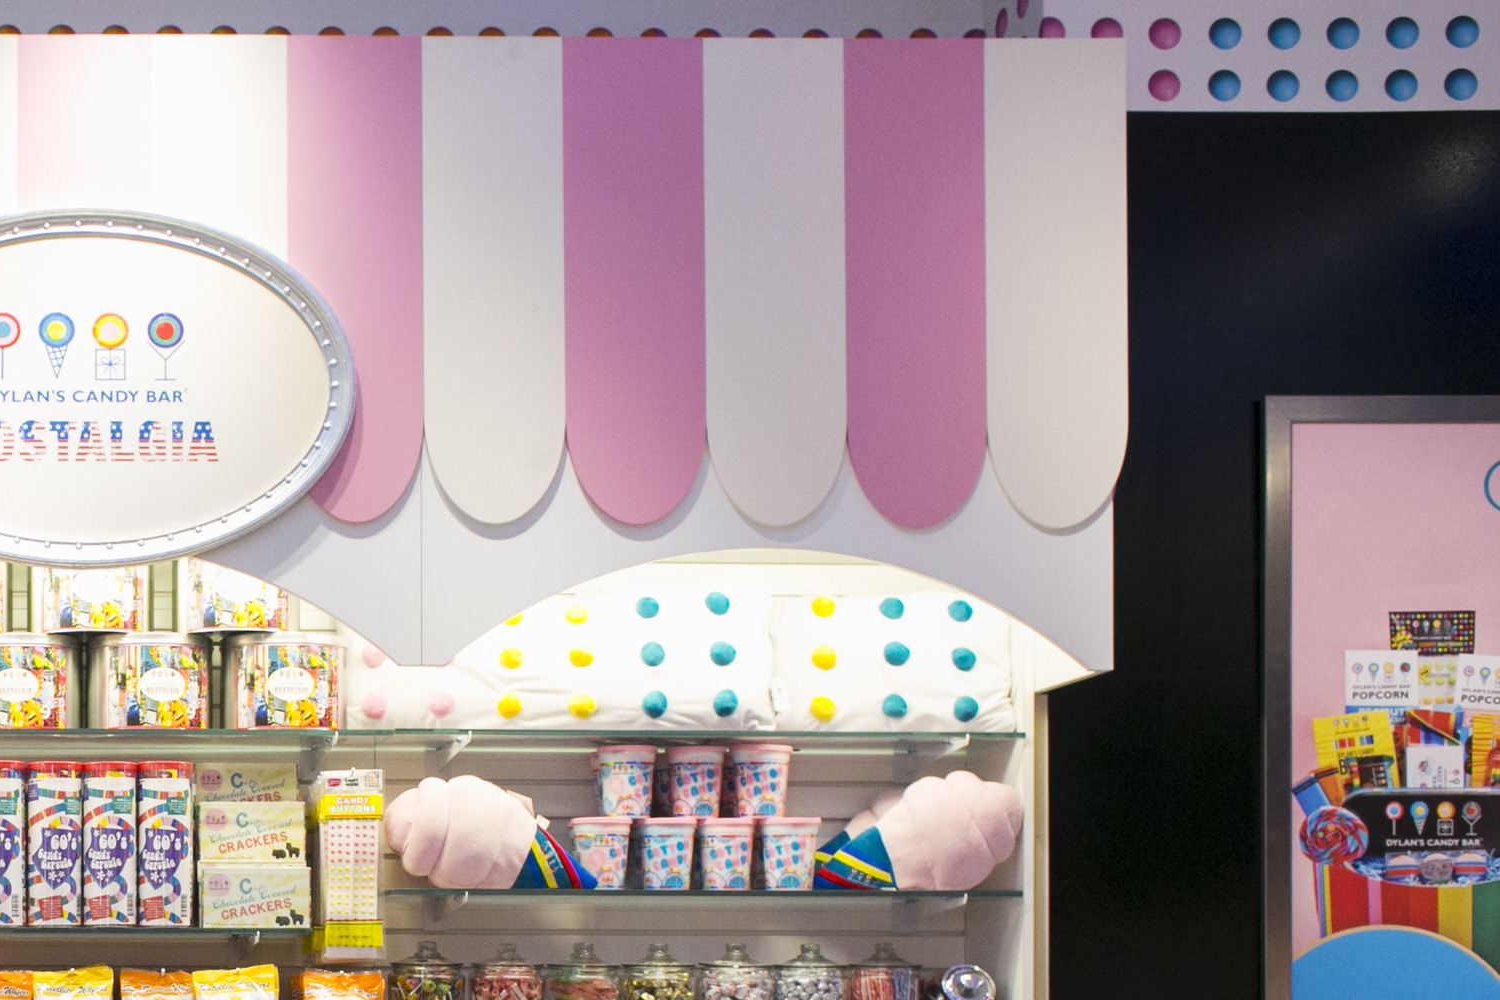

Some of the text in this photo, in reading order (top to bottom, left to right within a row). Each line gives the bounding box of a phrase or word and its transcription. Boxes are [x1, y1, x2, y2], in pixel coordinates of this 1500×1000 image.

[73, 389, 141, 403] CANDY
[146, 389, 184, 403] BAR
[1352, 691, 1409, 700] POPCORN
[329, 804, 376, 814] BUTTONS
[335, 796, 369, 805] CANDY
[50, 832, 77, 850] 60's
[99, 831, 128, 850] 60's
[152, 832, 182, 851] 60's
[218, 831, 289, 854] CRACKERS
[1386, 838, 1482, 847] DYLAN'S CANDY BAR
[211, 884, 298, 910] Chocolate Covered
[220, 897, 293, 920] CRACKERS
